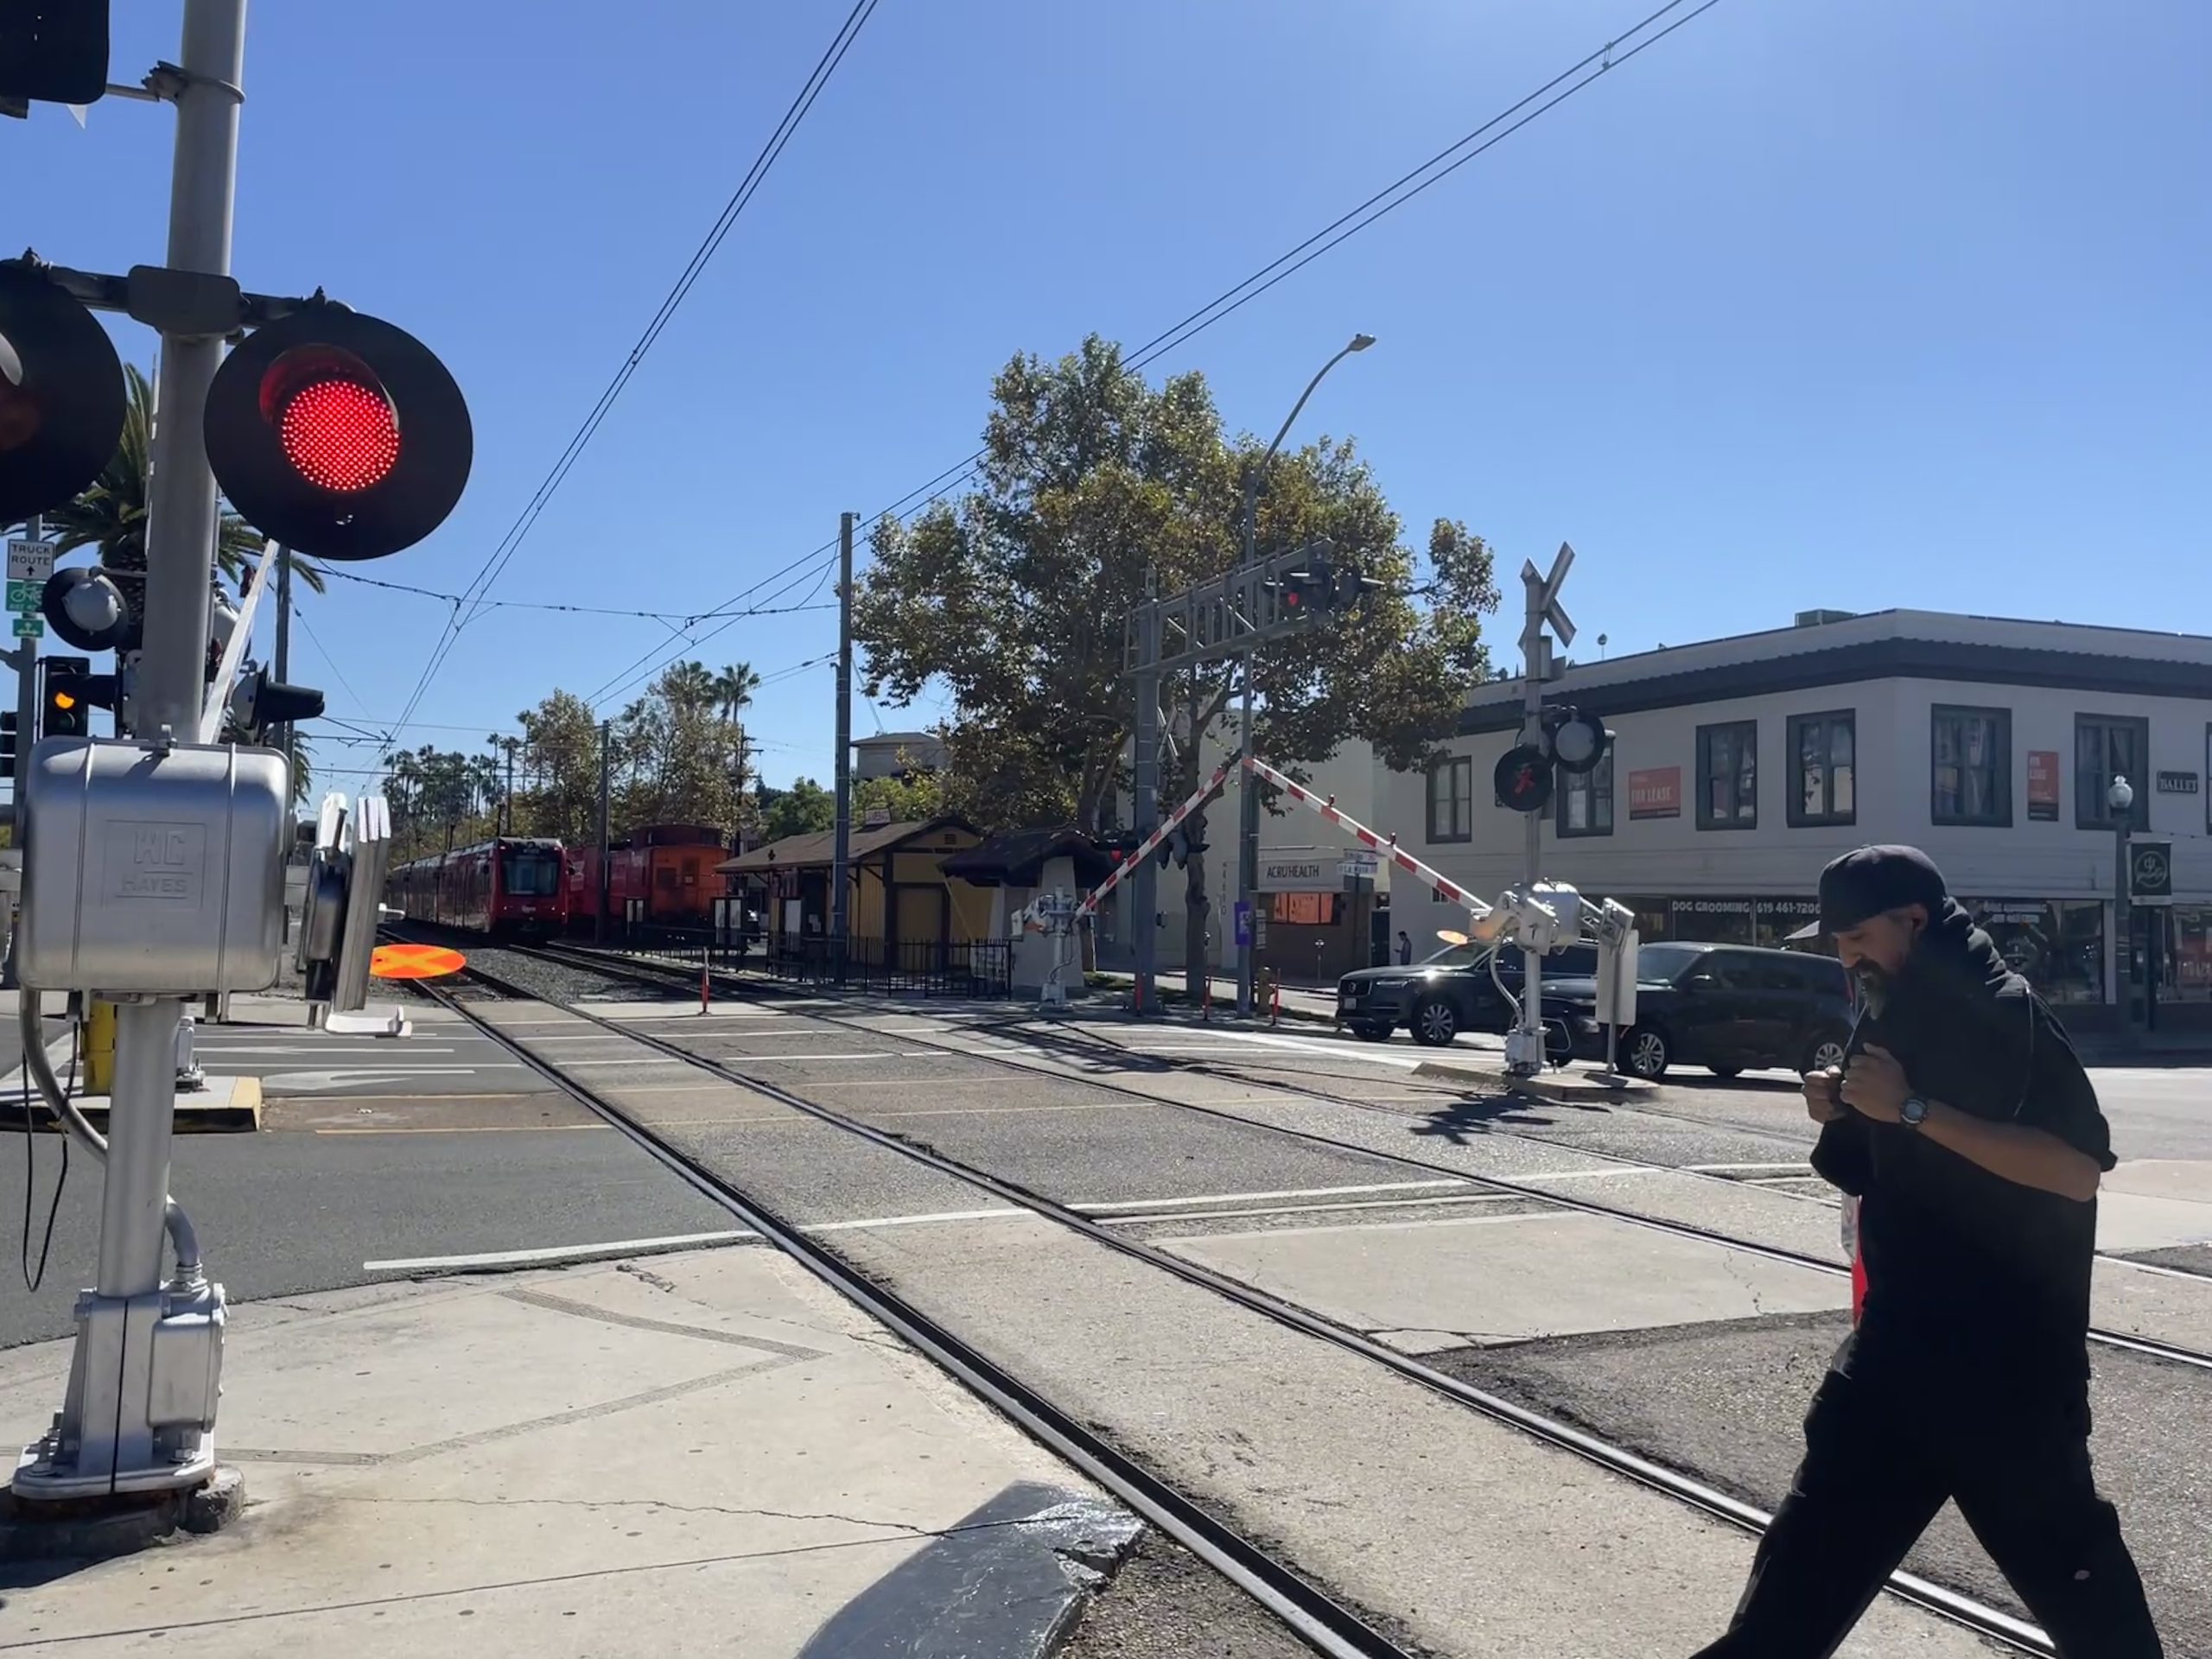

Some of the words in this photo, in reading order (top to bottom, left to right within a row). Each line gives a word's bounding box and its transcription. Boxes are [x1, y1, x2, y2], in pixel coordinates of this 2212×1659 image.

[11, 543, 51, 555] TRUCK
[11, 555, 50, 566] ROUTE
[2159, 778, 2197, 792] BALLET
[1647, 785, 1673, 803] LEASE
[122, 874, 188, 893] HAYES
[1672, 901, 1694, 912] DOG
[1695, 901, 1750, 913] GROOMING
[1757, 902, 1774, 913] 619
